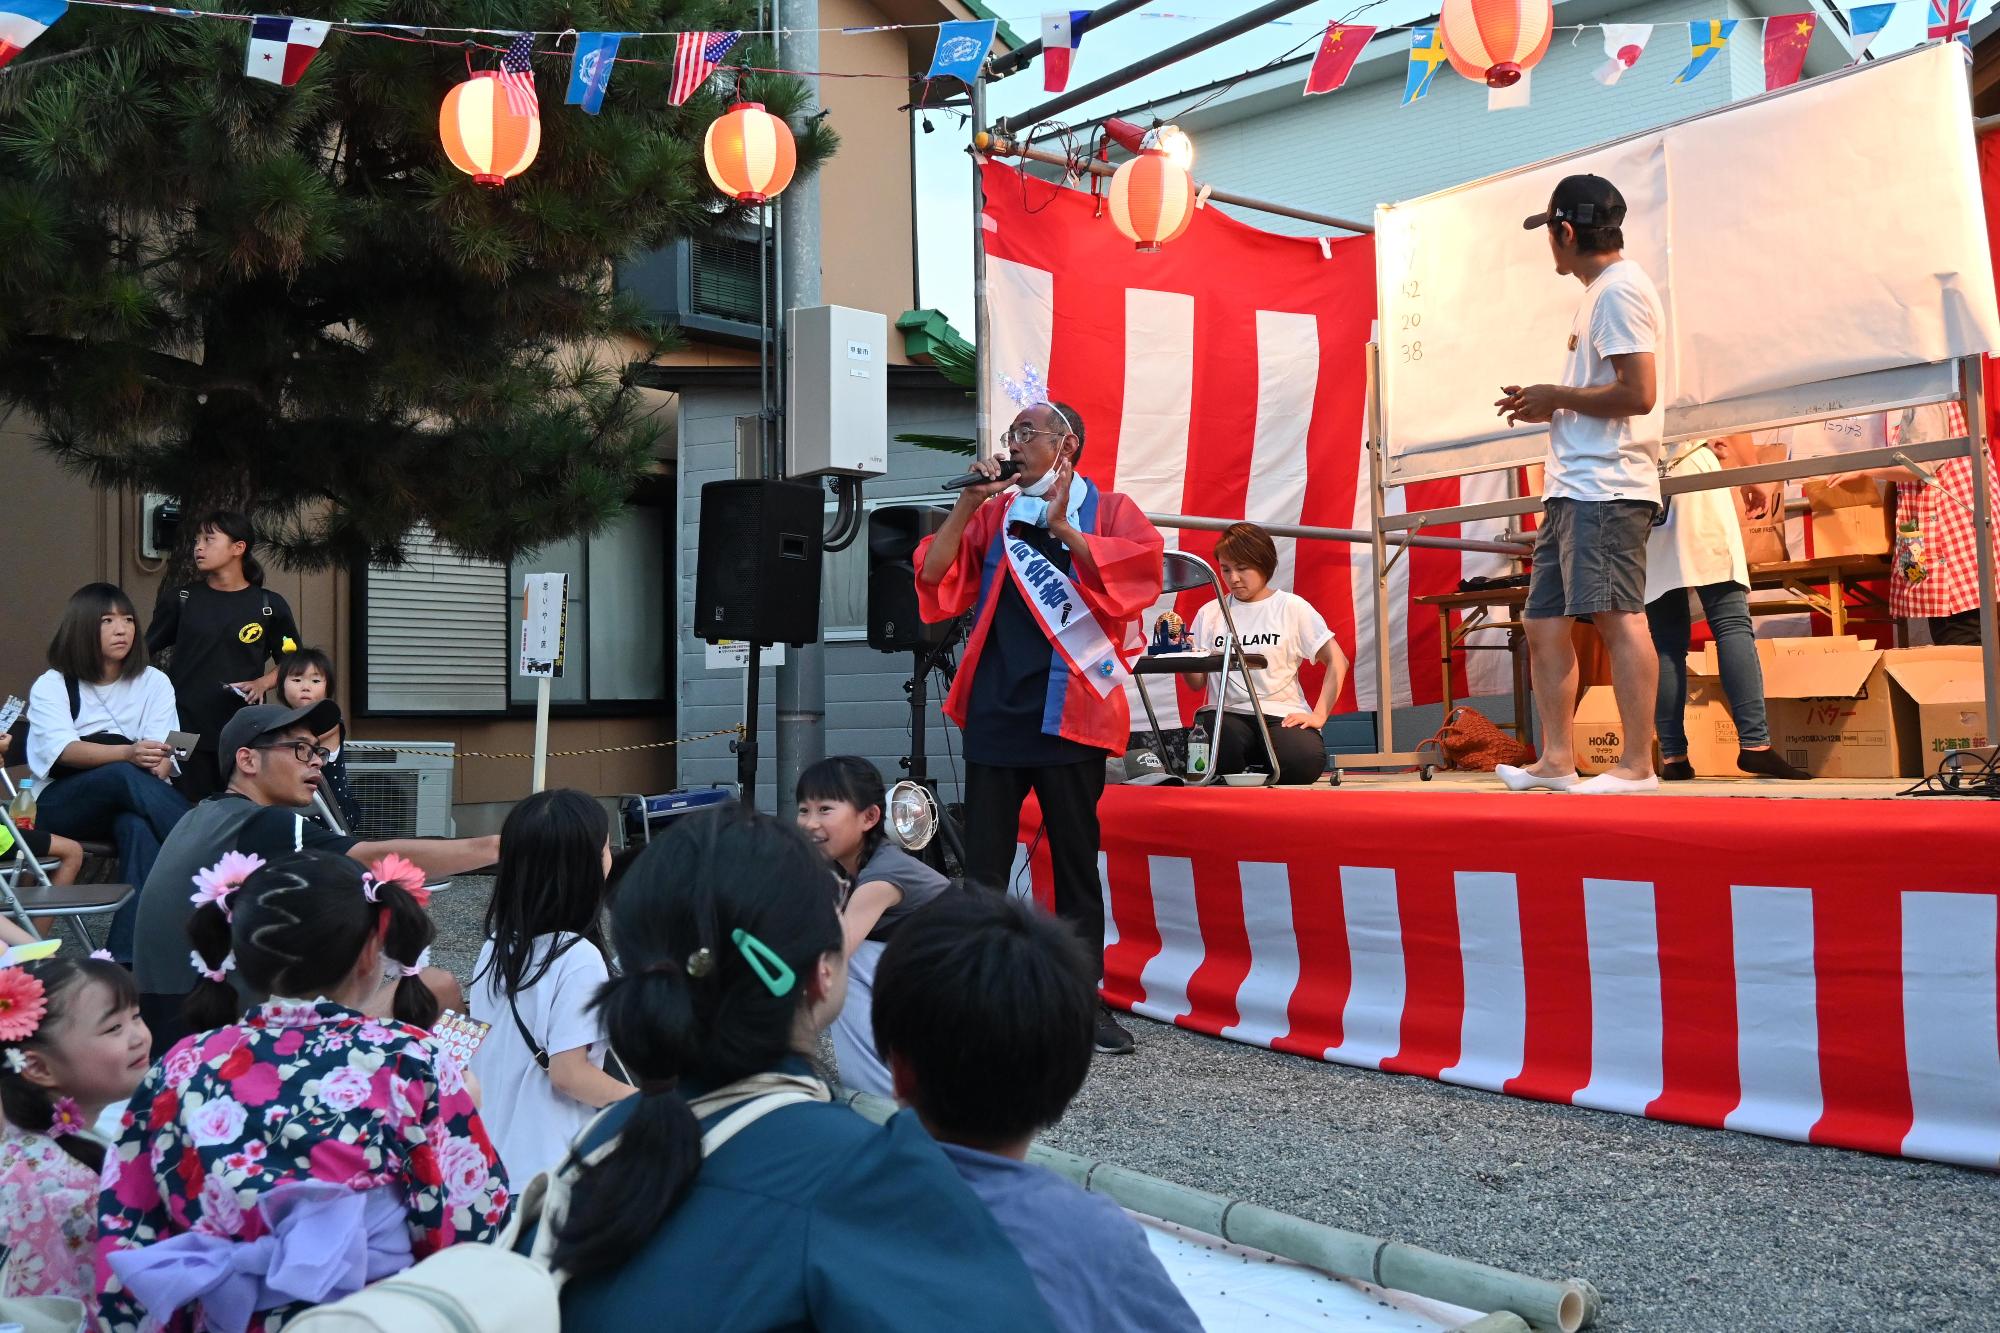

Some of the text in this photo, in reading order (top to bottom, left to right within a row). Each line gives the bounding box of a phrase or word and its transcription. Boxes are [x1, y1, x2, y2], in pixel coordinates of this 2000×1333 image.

[1402, 312, 1421, 330] 20
[1401, 340, 1423, 364] 38
[1214, 633, 1281, 647] GLANT
[1806, 704, 1857, 726] バター
